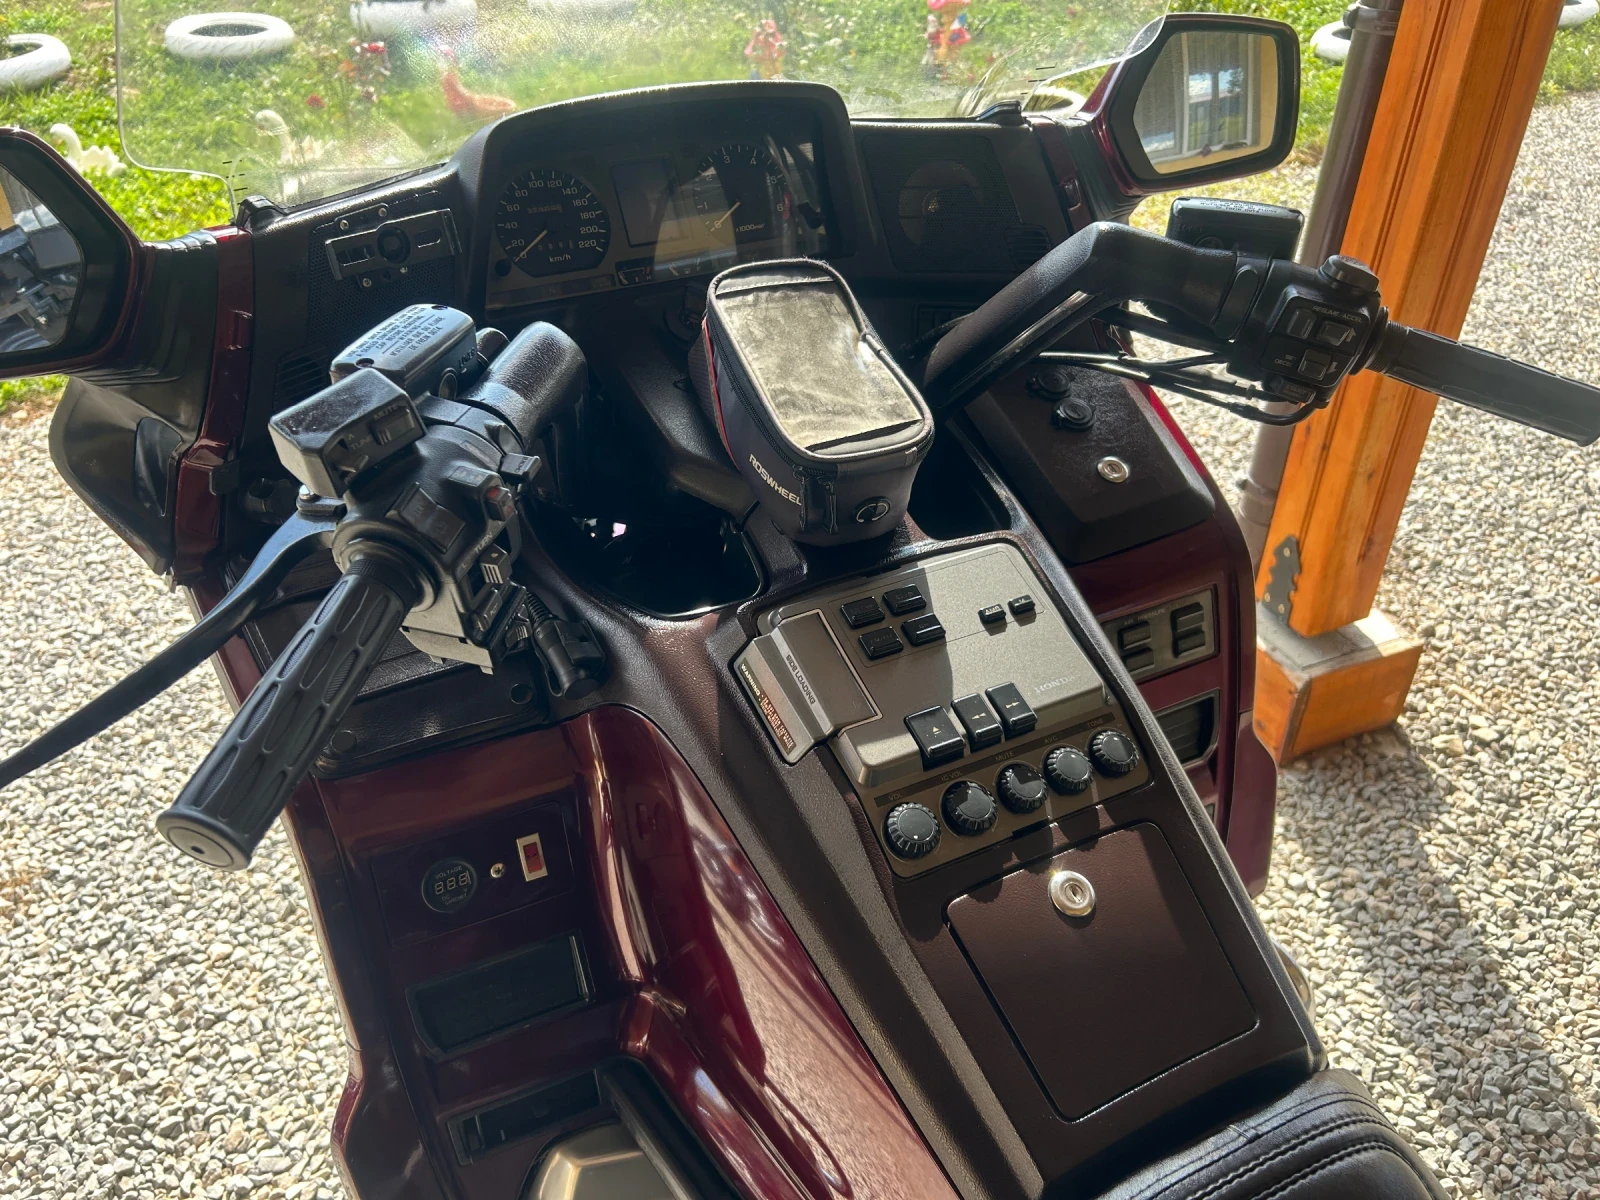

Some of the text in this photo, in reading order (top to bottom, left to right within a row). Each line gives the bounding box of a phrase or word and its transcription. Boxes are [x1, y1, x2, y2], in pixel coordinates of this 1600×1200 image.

[724, 155, 731, 163] 3
[750, 157, 757, 165] 4
[528, 180, 544, 188] 100
[547, 180, 563, 188] 120
[515, 189, 528, 197] 80
[562, 187, 578, 195] 140
[573, 199, 588, 207] 160
[777, 203, 783, 211] 6
[580, 211, 596, 219] 180
[580, 225, 598, 234] 200
[511, 239, 525, 247] 20
[578, 239, 597, 248] 220
[549, 254, 572, 263] km/h
[749, 453, 802, 506] ROSWHEEL
[740, 662, 761, 697] WARNING
[786, 654, 816, 706] SIDE LOADING
[995, 751, 1014, 761] MUTE
[950, 770, 963, 779] VOL
[888, 792, 903, 801] VOL
[434, 865, 463, 879] VOLTAGE
